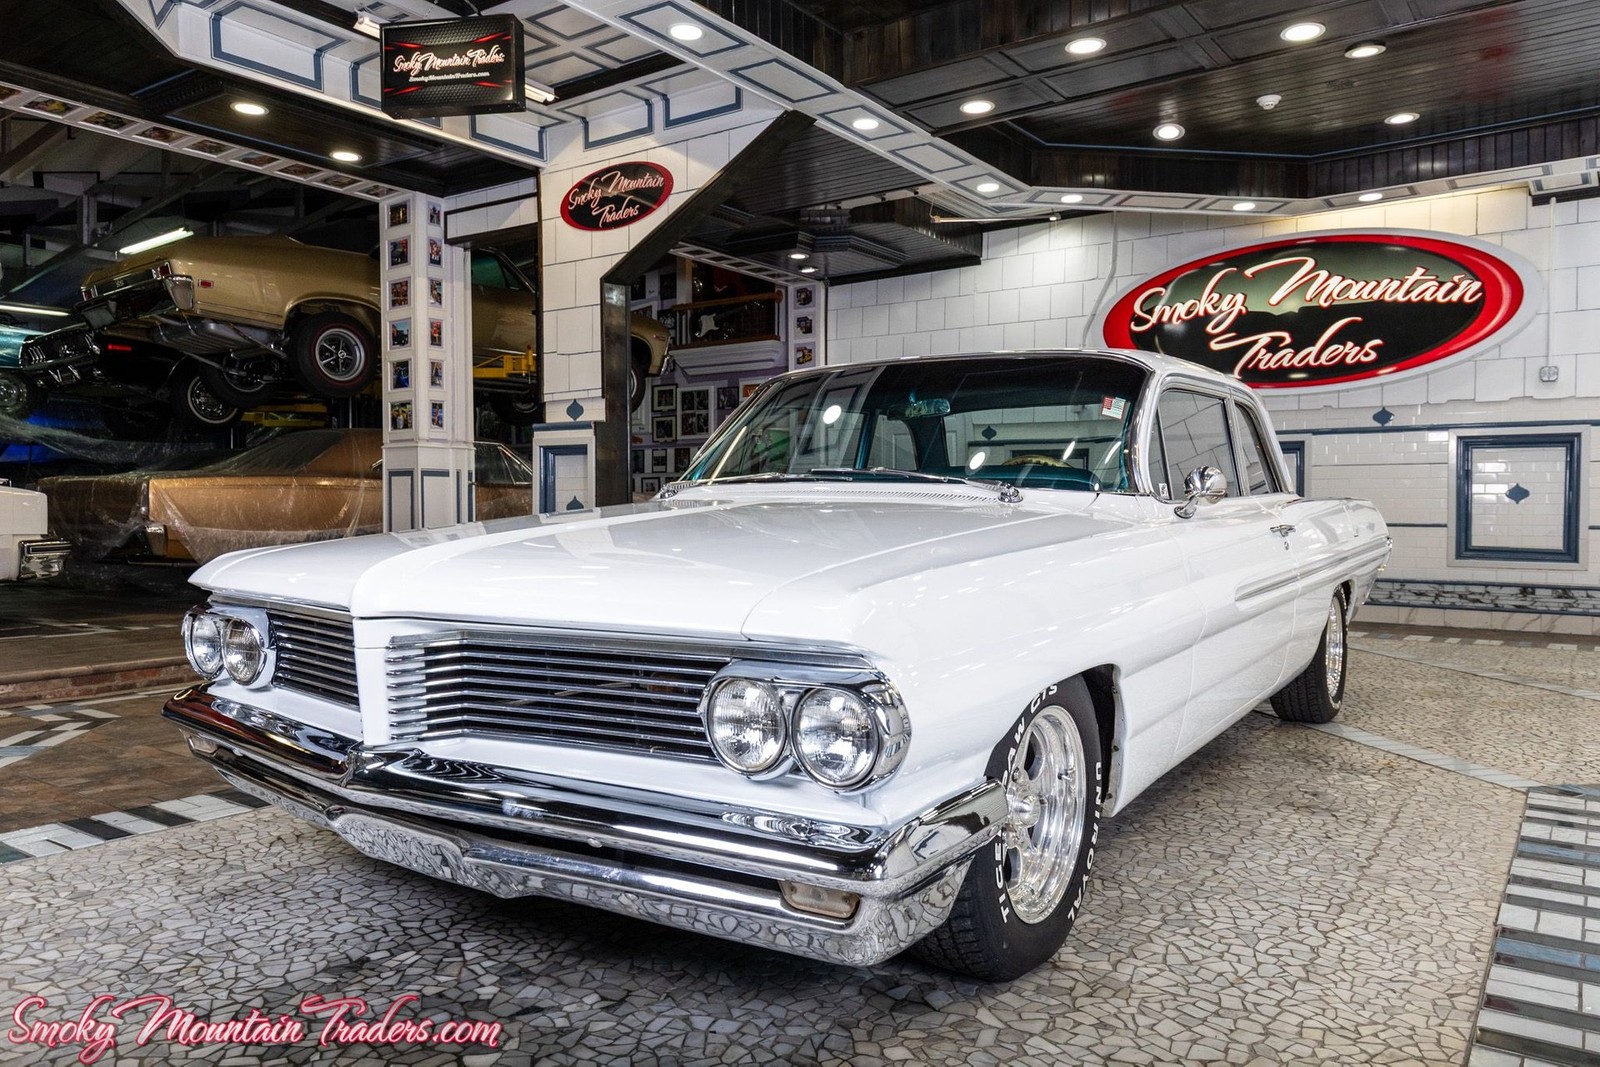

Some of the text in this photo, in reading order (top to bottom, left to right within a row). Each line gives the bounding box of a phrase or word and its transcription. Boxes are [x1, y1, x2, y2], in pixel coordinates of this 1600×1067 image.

[393, 44, 505, 76] Smoky Mountain Traders
[568, 170, 665, 210] Smoky Mountain
[591, 195, 640, 228] Traders
[1129, 256, 1486, 335] Smoky Mountain
[1209, 316, 1385, 380] Traders
[1067, 761, 1102, 922] UNIROYAL
